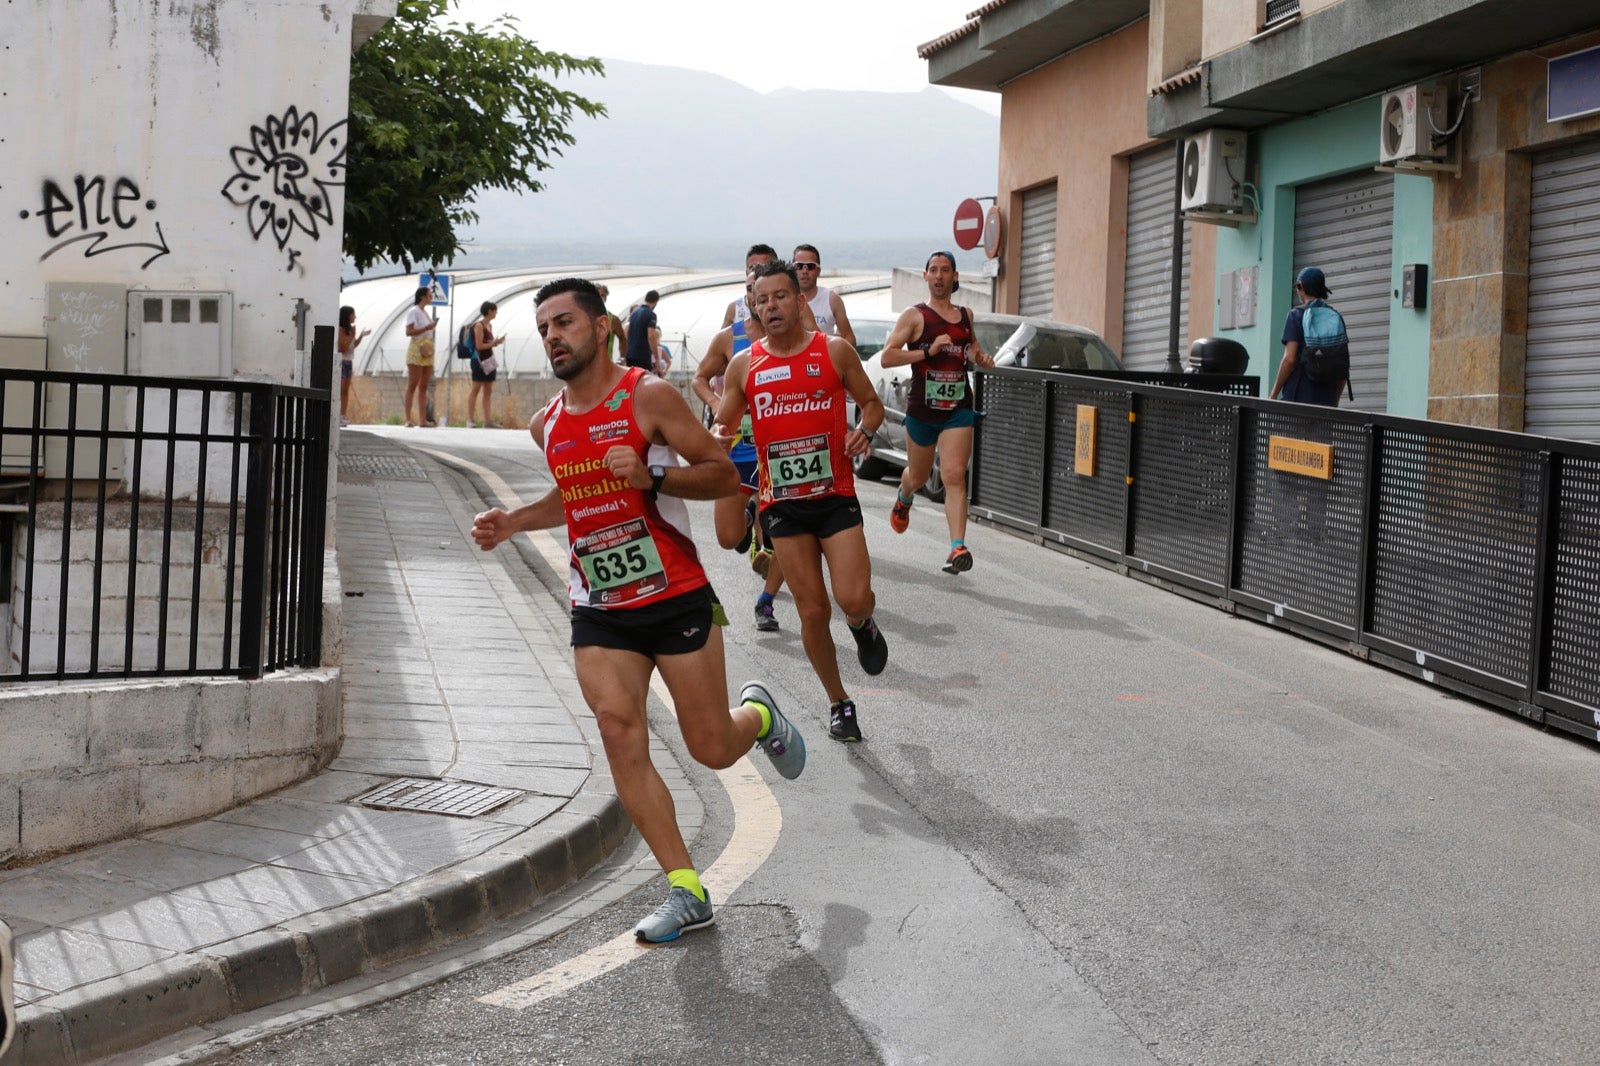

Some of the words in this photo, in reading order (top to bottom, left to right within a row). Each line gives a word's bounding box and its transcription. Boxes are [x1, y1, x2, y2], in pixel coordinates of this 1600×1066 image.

[776, 392, 807, 402] Clínicas
[937, 384, 956, 398] 45
[754, 392, 832, 420] Polisalud
[588, 419, 629, 434] MotorDOS
[780, 454, 823, 481] 634
[572, 500, 619, 521] Continental
[592, 544, 647, 583] 635
